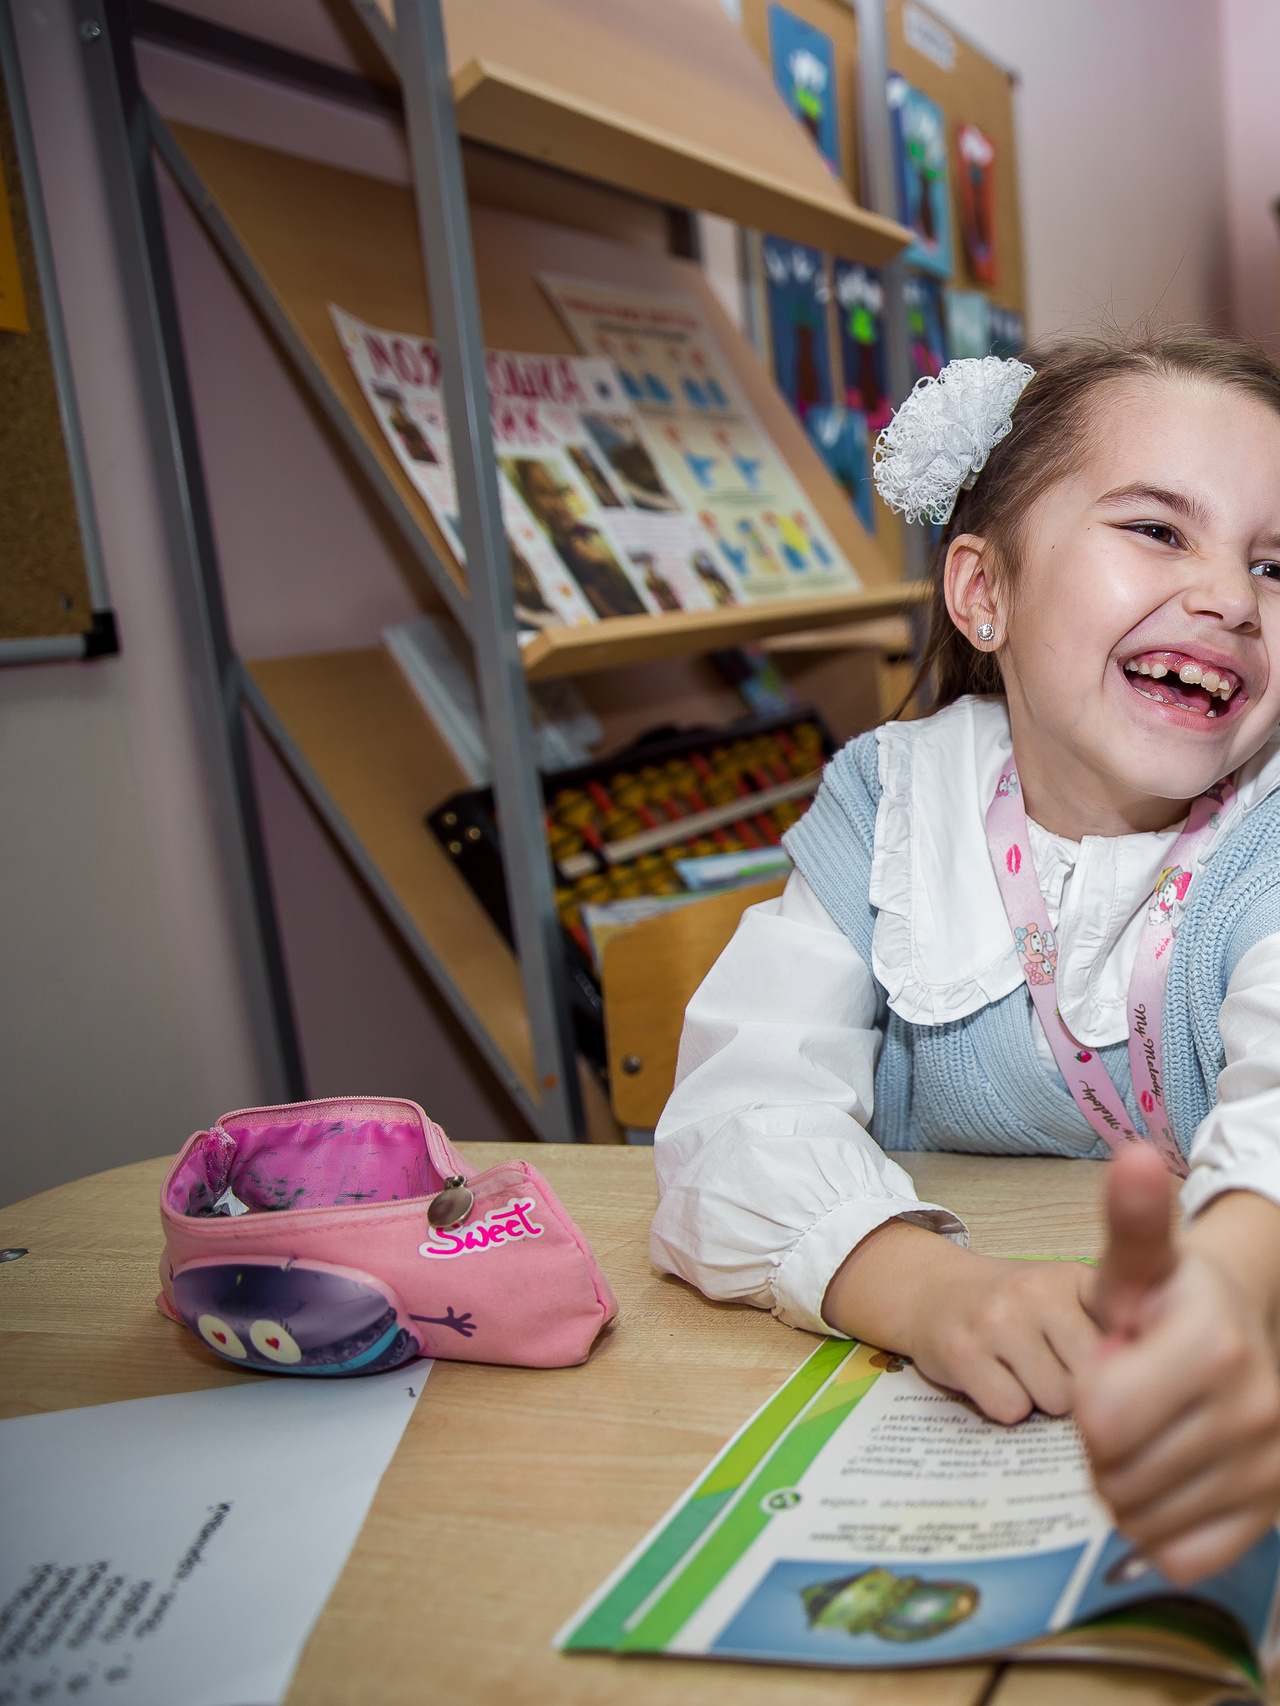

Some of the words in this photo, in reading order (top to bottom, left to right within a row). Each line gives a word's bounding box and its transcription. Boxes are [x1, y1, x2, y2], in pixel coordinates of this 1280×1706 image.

[1133, 1003, 1147, 1038] My
[1143, 1038, 1163, 1106] Melody
[1079, 1080, 1120, 1130] Melody
[427, 1203, 541, 1254] Sweet
